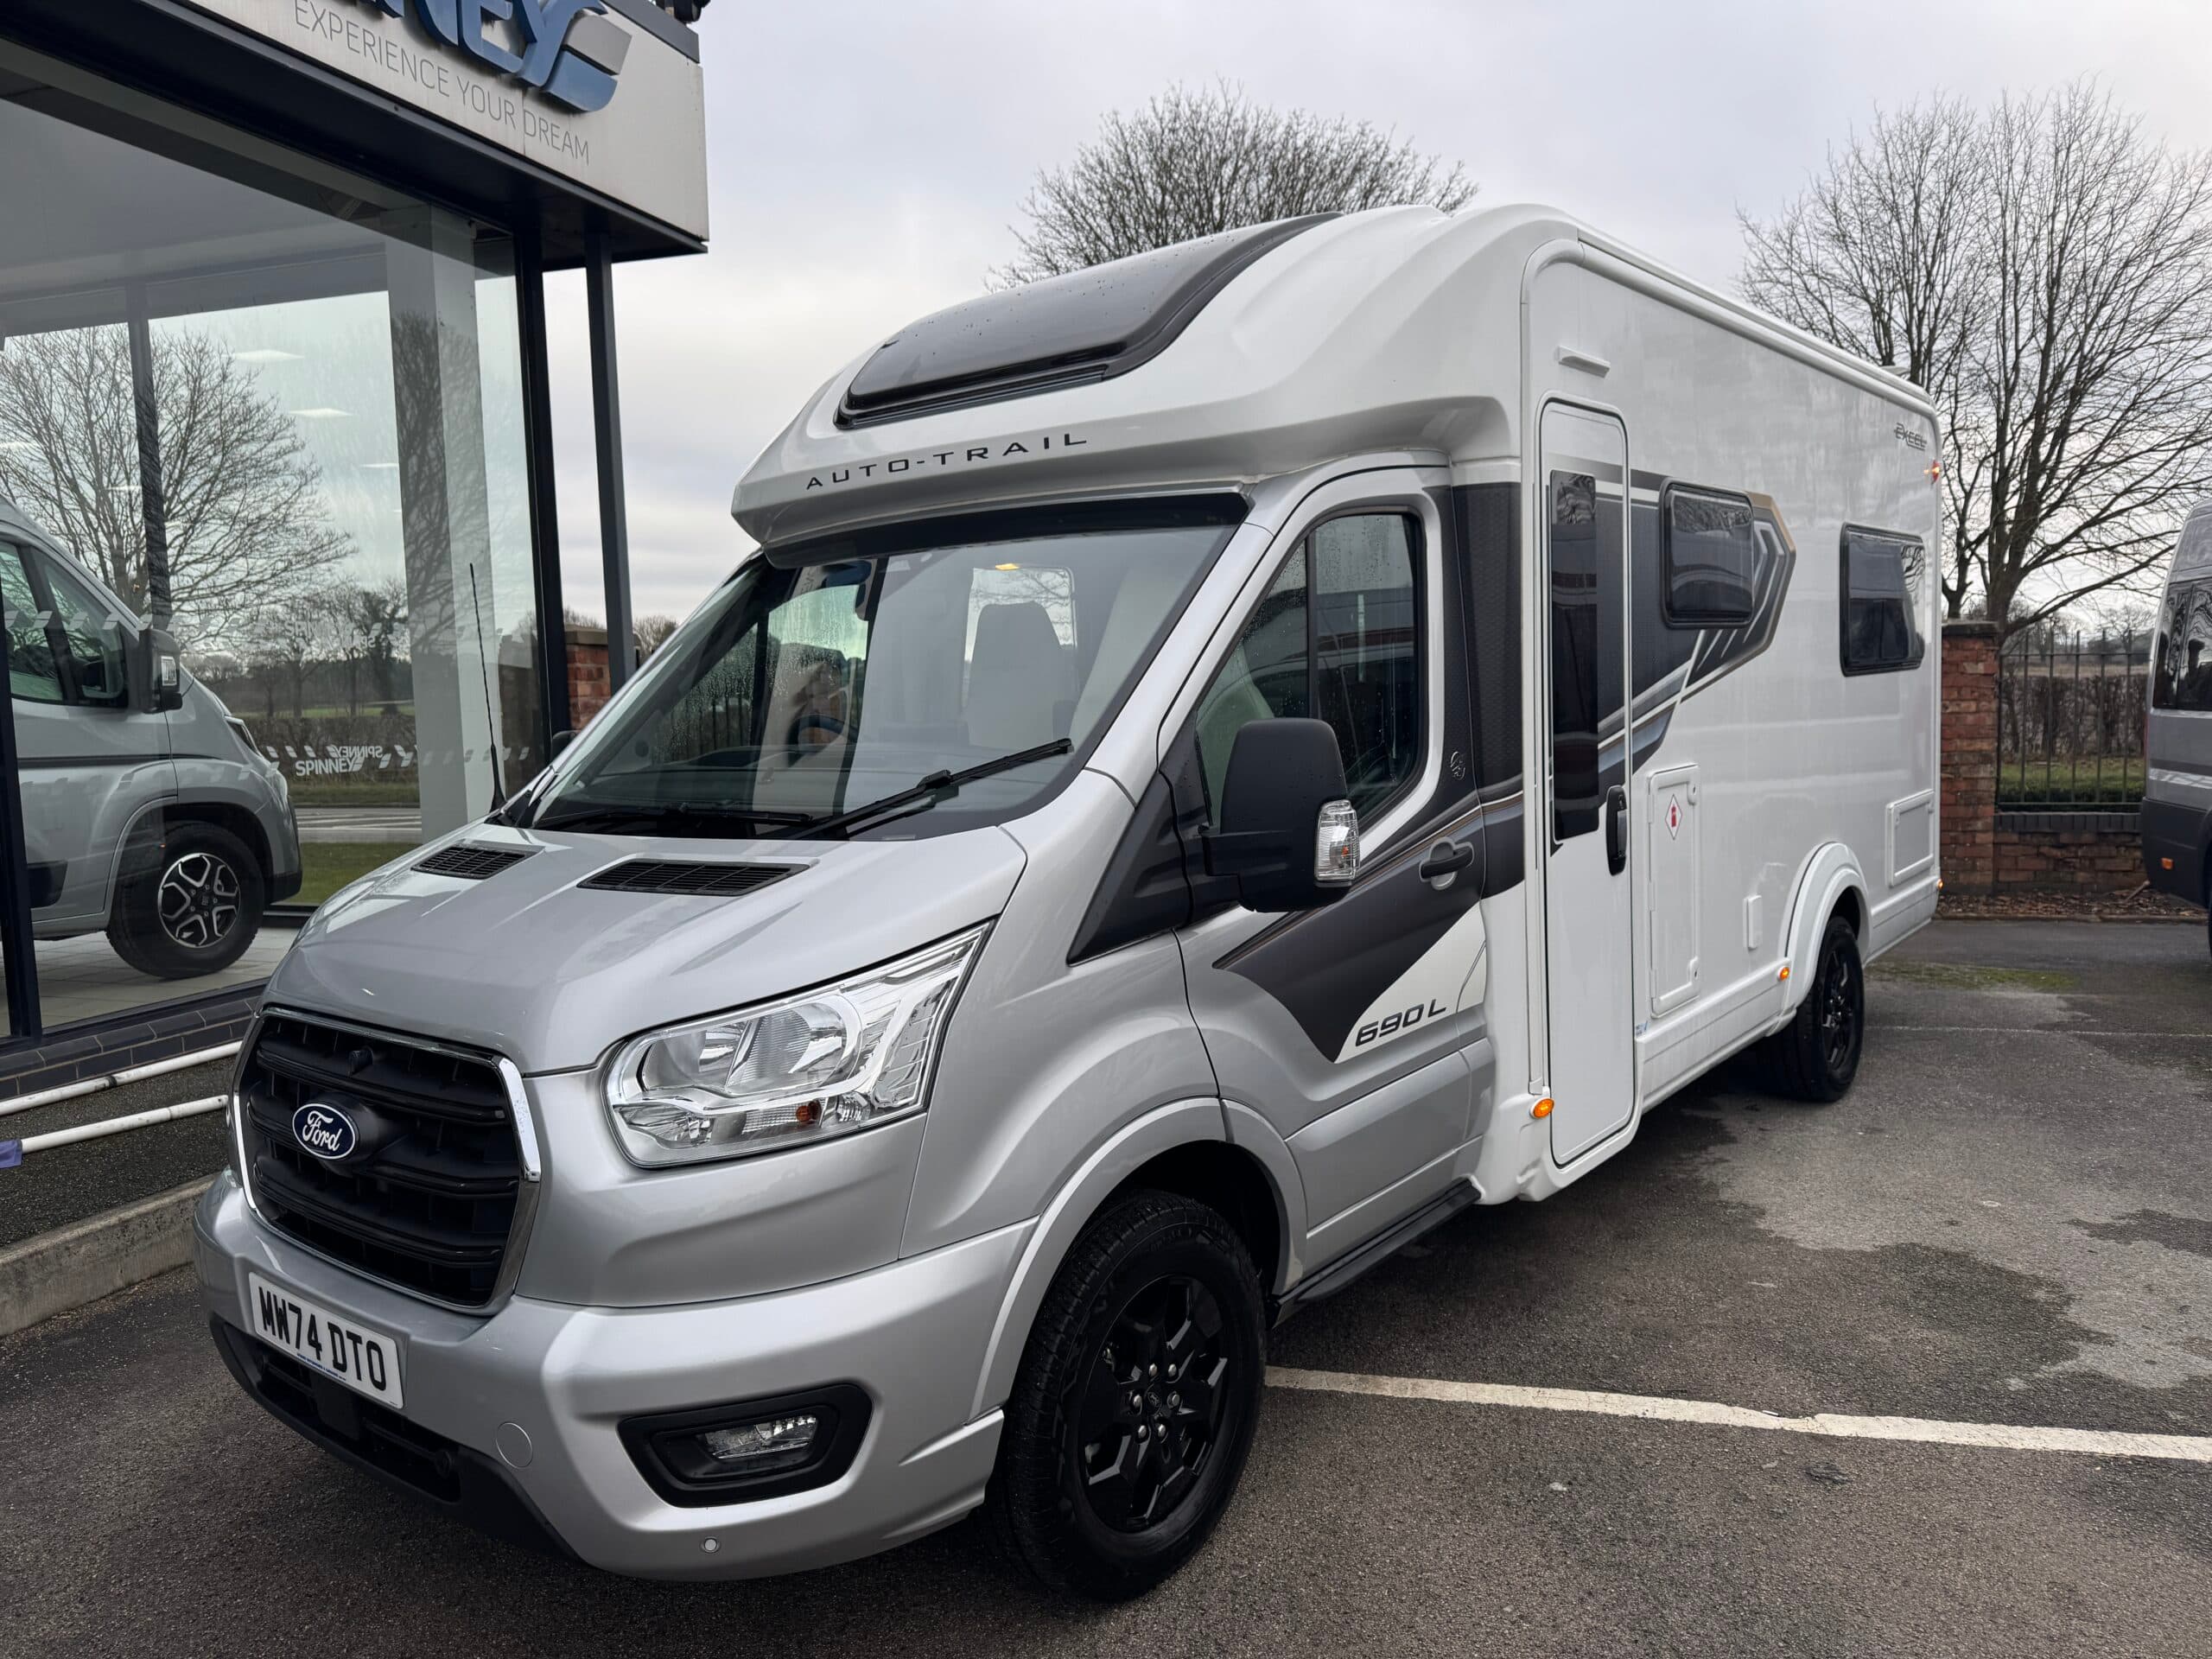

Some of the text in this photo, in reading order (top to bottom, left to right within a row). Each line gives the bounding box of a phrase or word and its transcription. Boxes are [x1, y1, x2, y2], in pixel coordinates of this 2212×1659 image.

[294, 0, 589, 167] EXPERIENCE YOUR DREAM
[805, 433, 1087, 490] AUTO-TRAIL
[296, 757, 357, 777] SPINNEY
[1355, 999, 1447, 1047] 690 L
[302, 1110, 342, 1152] Ford
[258, 1286, 387, 1392] MW74 DTO
